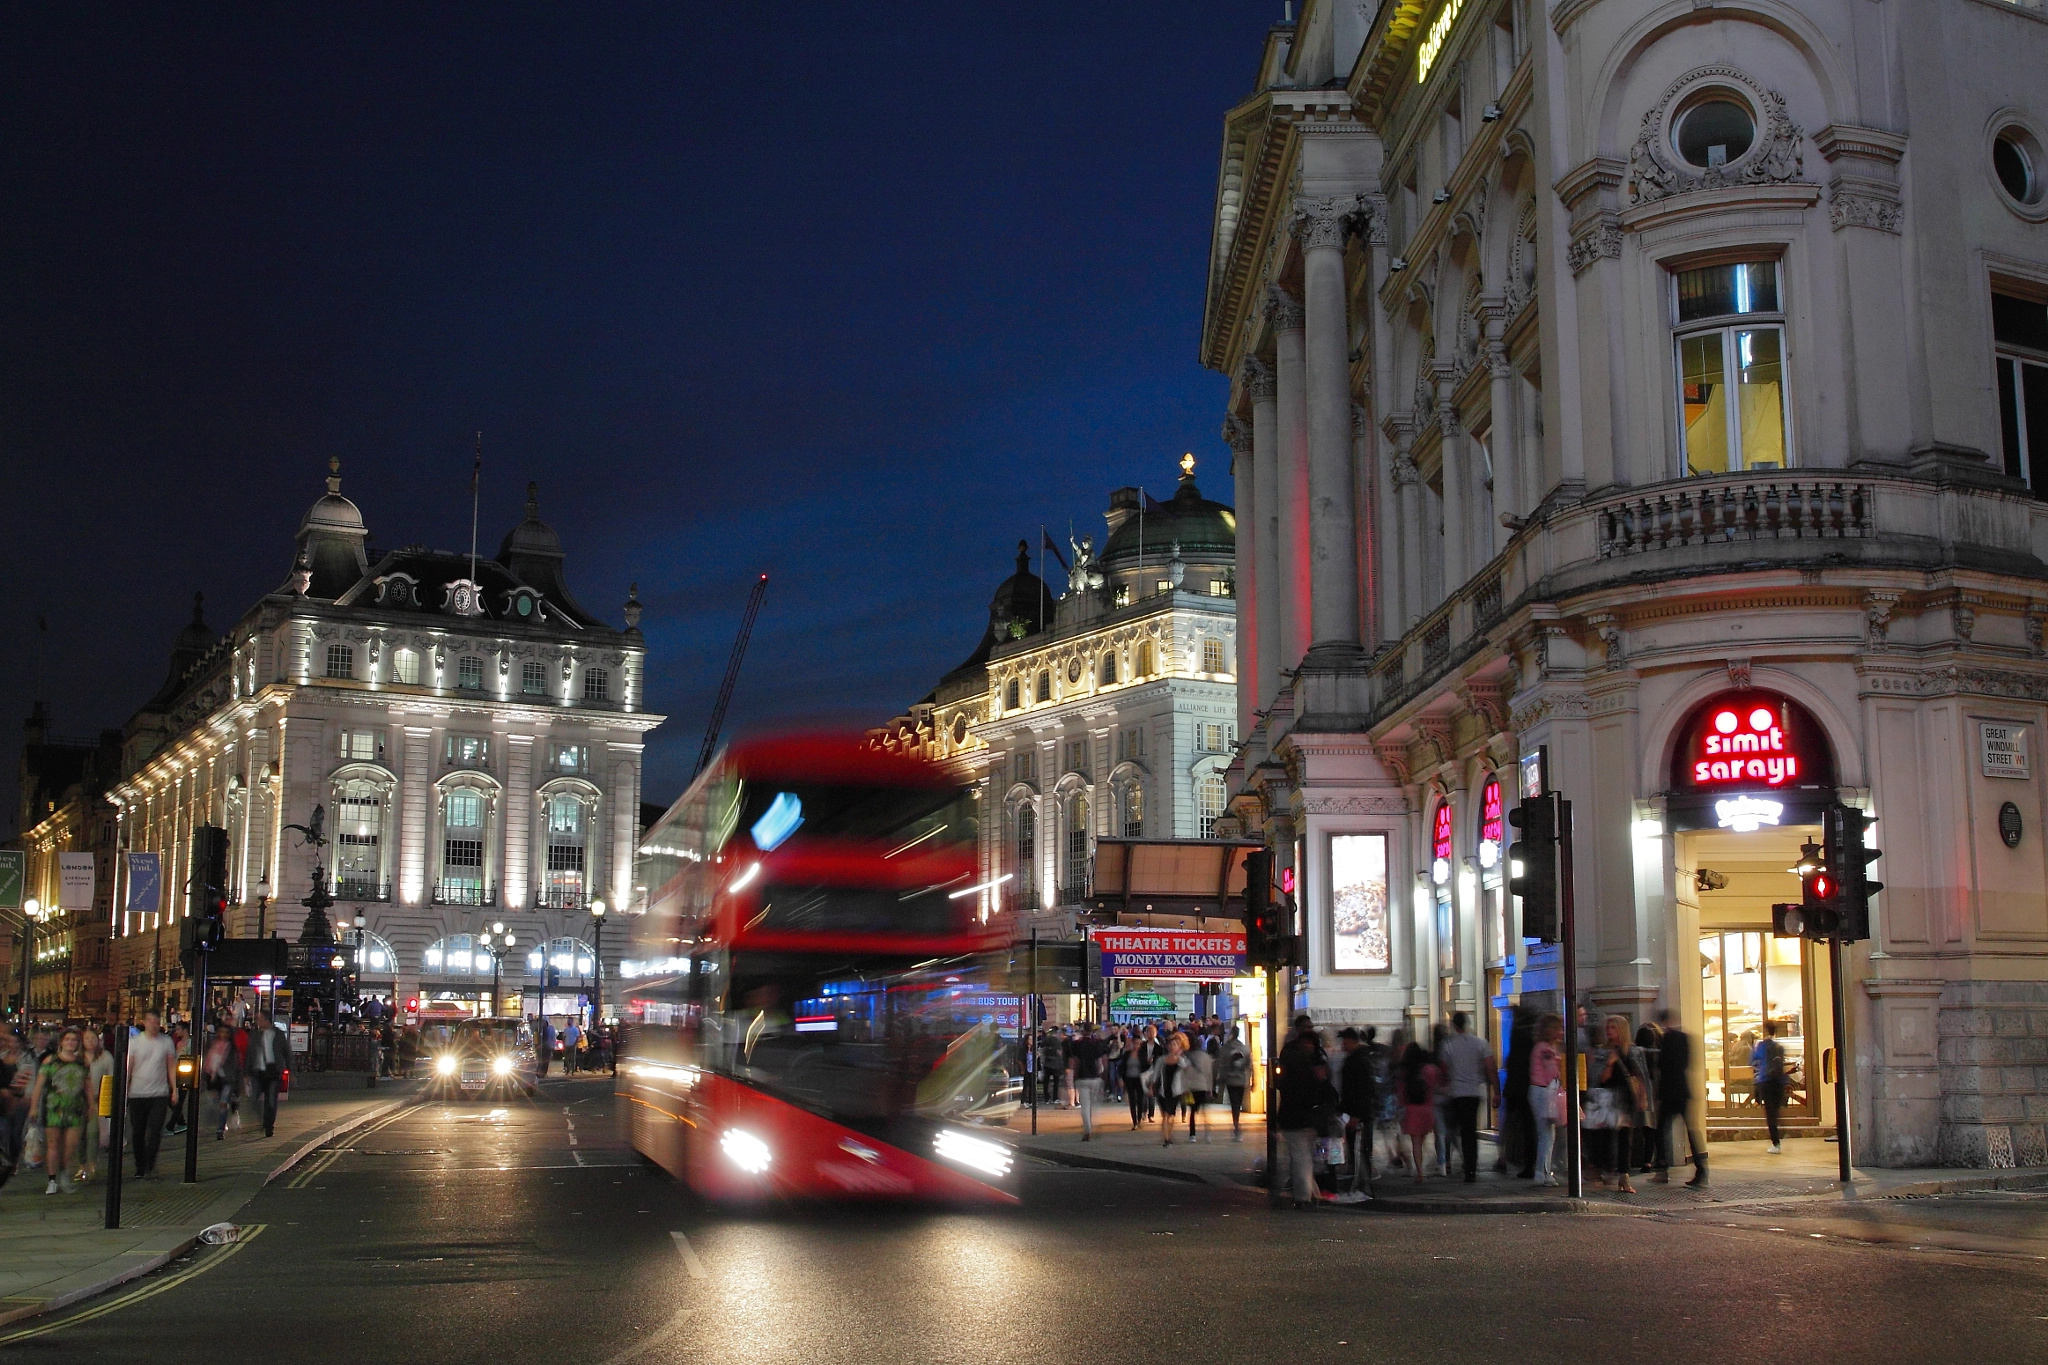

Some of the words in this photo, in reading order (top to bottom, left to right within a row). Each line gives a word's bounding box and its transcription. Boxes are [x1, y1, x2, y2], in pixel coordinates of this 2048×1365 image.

[1419, 3, 1452, 84] Believe
[1986, 728, 2007, 740] GREAT
[1986, 740, 2020, 753] WINDMILL
[1987, 752, 2012, 765] STREET
[2015, 755, 2025, 765] W1
[1104, 937, 1169, 950] THEATRE
[1173, 938, 1232, 950] TICKETS
[1236, 940, 1246, 951] &
[1115, 954, 1162, 966] MONEY
[1164, 954, 1235, 966] EXCHANGE
[978, 997, 995, 1005] BUS
